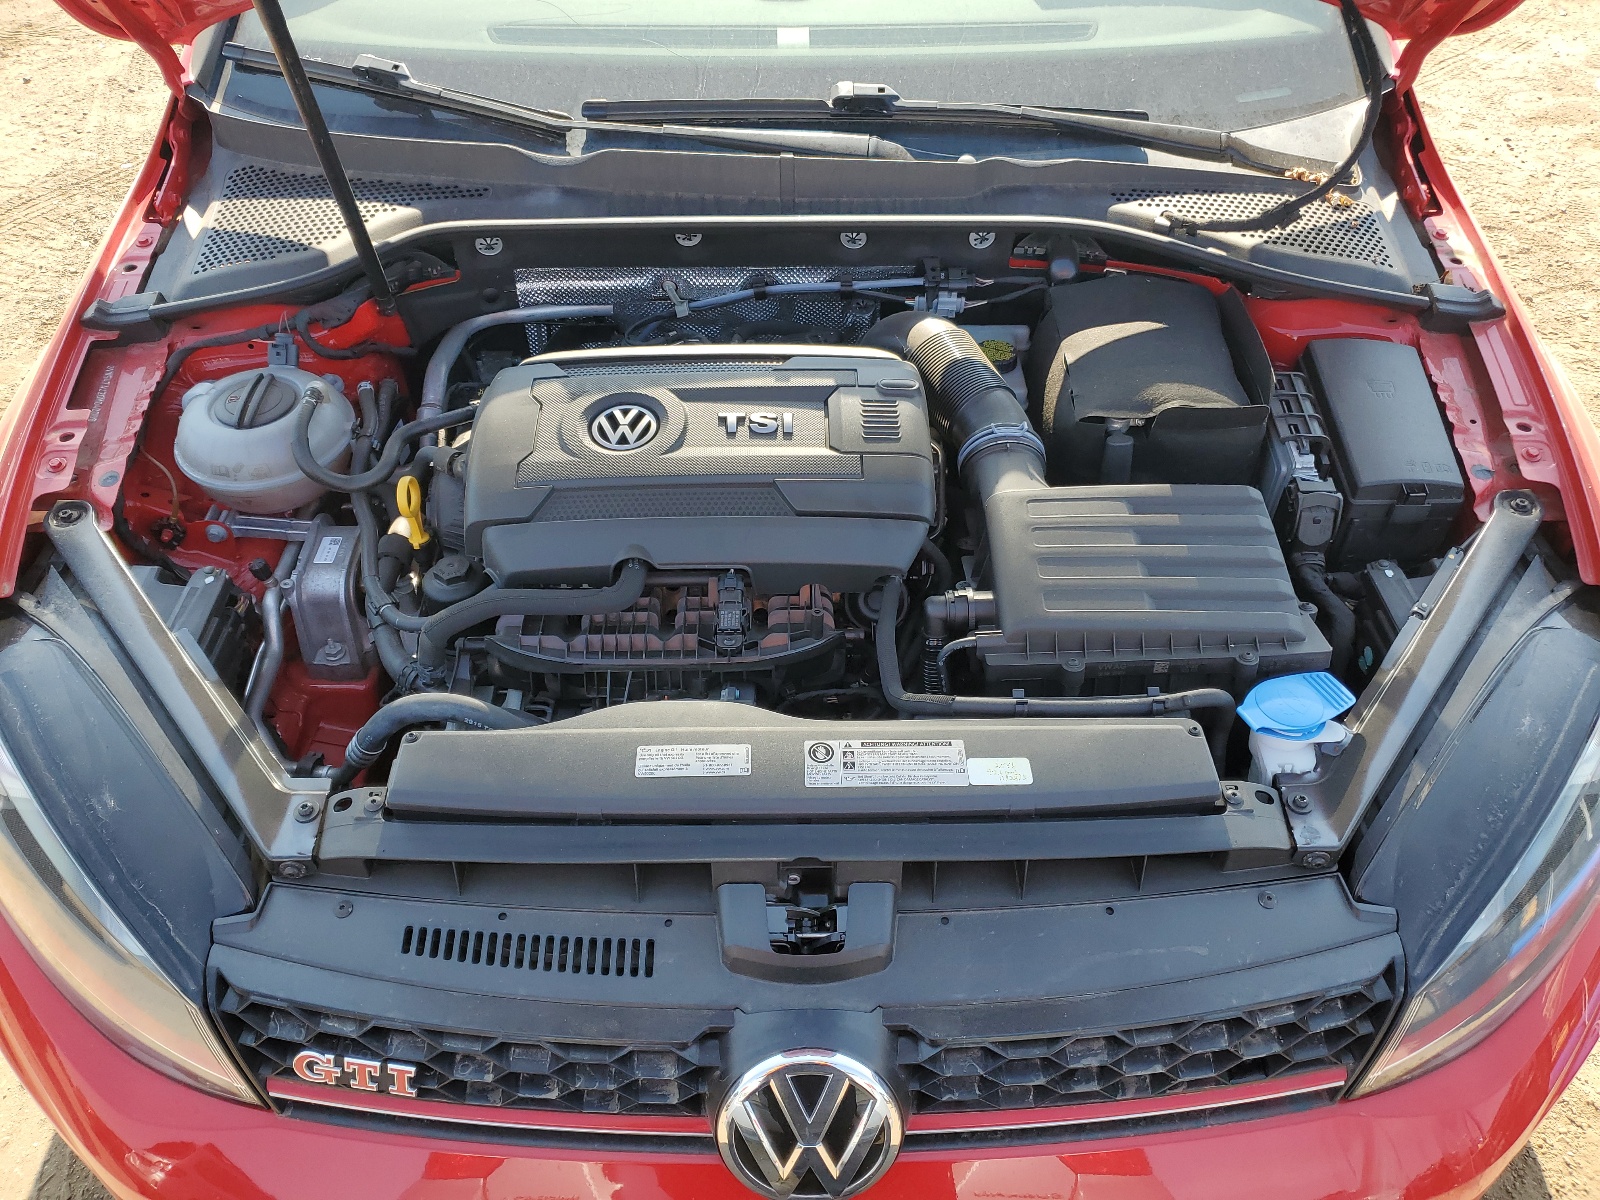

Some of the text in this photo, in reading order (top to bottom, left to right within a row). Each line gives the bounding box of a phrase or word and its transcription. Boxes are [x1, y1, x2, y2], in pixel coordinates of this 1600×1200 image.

[594, 405, 656, 449] VW
[717, 412, 794, 434] TSI
[292, 1050, 418, 1097] GTI
[721, 1057, 897, 1200] VW
